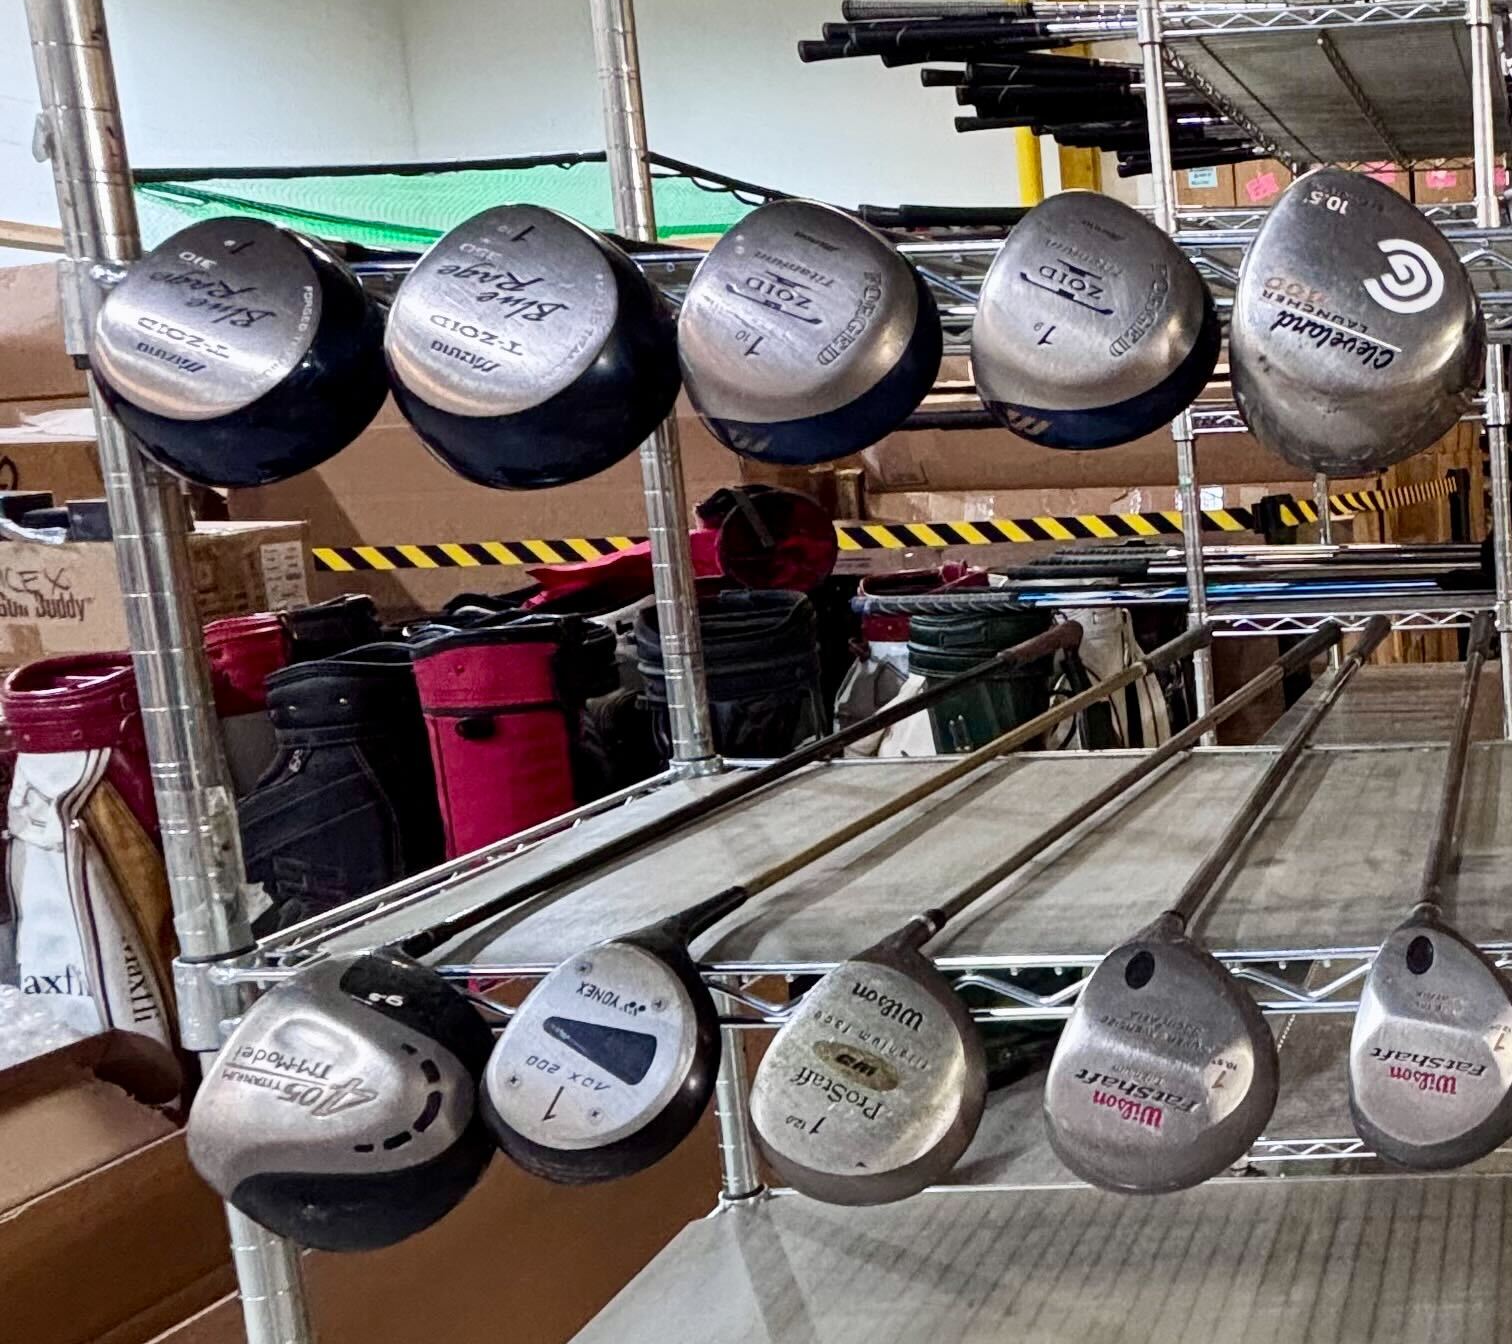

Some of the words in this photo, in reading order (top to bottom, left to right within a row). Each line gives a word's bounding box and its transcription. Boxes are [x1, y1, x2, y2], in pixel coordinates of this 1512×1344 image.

[149, 269, 254, 299] Rage
[437, 263, 543, 296] Rage
[744, 276, 813, 310] ZOID
[1038, 264, 1103, 300] ZOID
[184, 297, 275, 328] Blue
[475, 291, 569, 322] Blue
[816, 271, 882, 367] FORGED
[1109, 262, 1168, 359] FORGED
[1262, 289, 1368, 333] LAUNCHER
[137, 317, 229, 358] T-ZOID
[429, 313, 524, 356] T-ZOID
[744, 336, 765, 358] 1
[1036, 326, 1056, 345] 1
[1271, 310, 1394, 371] Cleveland
[576, 982, 622, 1008] YONEX
[850, 982, 923, 1032] Wilson
[525, 1055, 561, 1074] 200
[1369, 1047, 1487, 1076] FatShaft
[790, 1067, 883, 1121] ProStaff
[1073, 1068, 1197, 1113] FatShaft
[1388, 1066, 1457, 1095] Wilson
[541, 1087, 565, 1122] 1
[1092, 1089, 1161, 1135] Wilson
